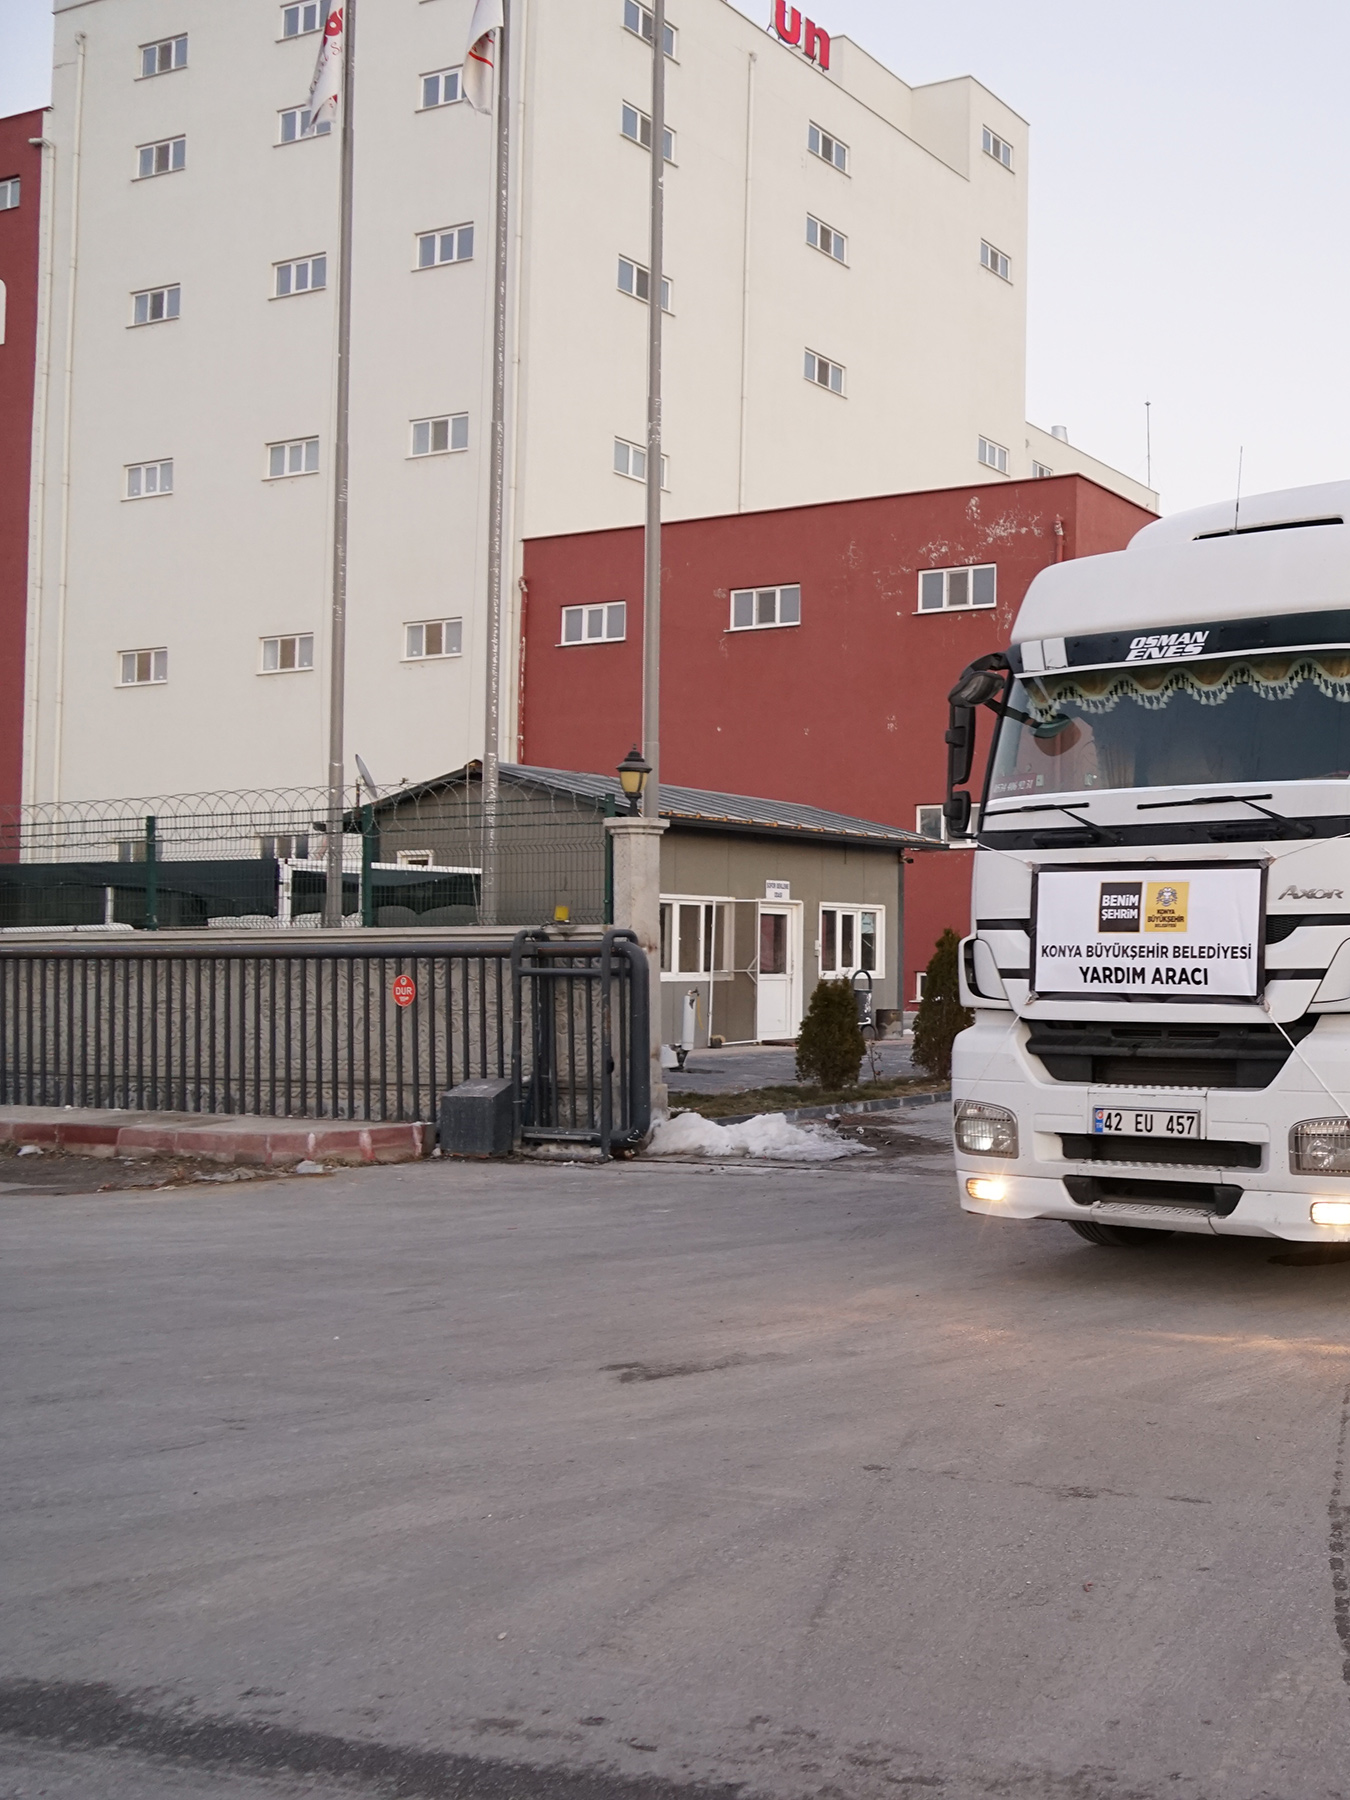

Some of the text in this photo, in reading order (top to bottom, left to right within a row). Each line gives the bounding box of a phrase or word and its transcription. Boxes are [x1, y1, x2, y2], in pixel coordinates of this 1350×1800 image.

[1129, 630, 1210, 649] OSMAN
[1124, 643, 1206, 661] ENES
[1041, 943, 1252, 960] KONYA BÜYÜKŞEHİR BELEDİYESİ
[1079, 967, 1209, 986] YARDIM ARACI
[395, 986, 412, 995] DUR
[1104, 1112, 1122, 1132] 42
[1135, 1113, 1153, 1133] EU
[1166, 1115, 1195, 1135] 457
